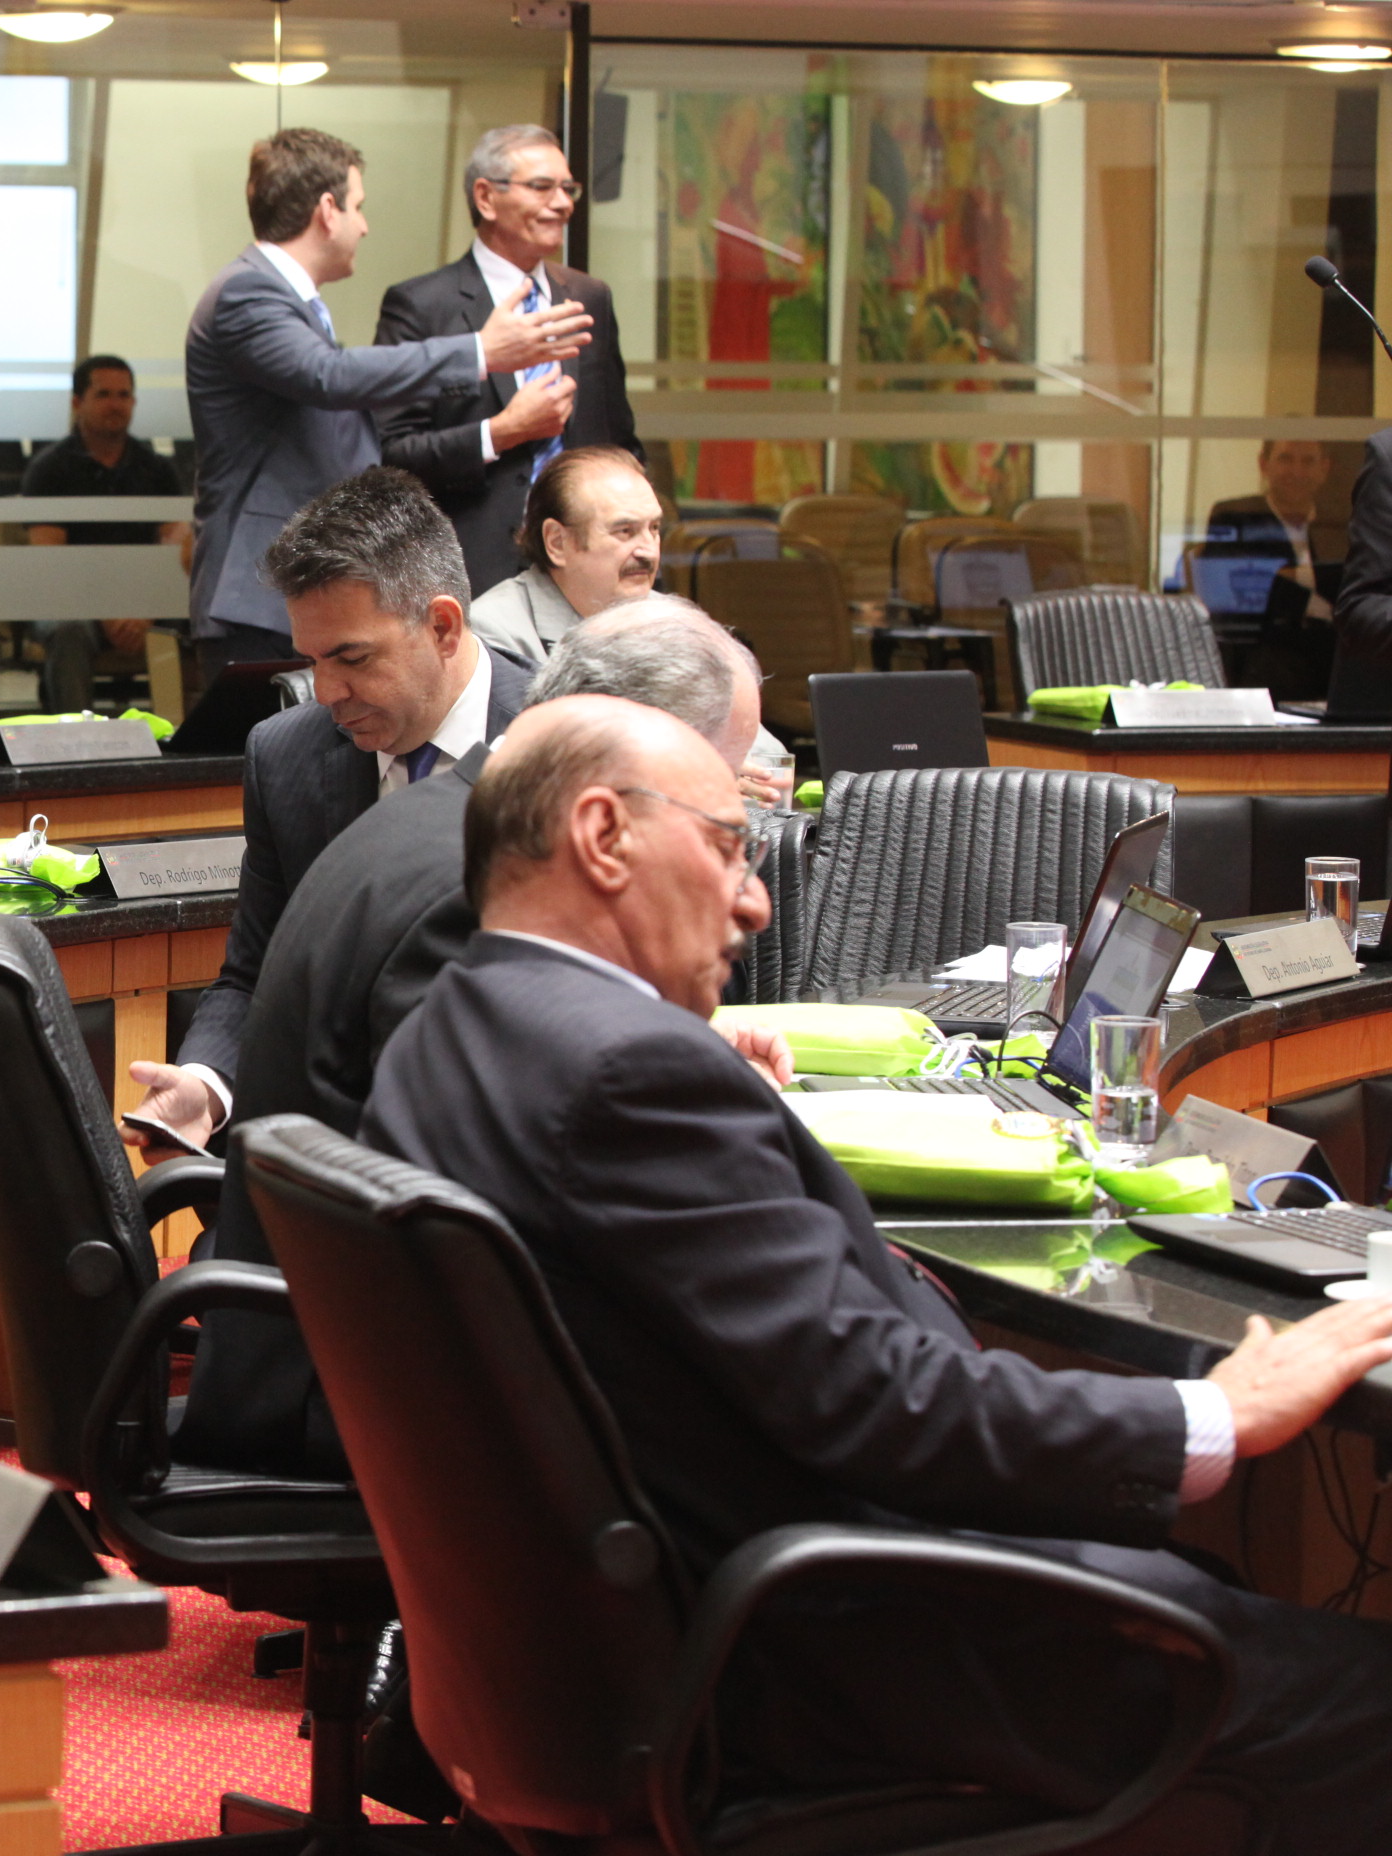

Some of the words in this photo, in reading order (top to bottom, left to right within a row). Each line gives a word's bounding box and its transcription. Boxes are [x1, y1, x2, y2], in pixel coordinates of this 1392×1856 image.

[139, 871, 166, 888] Dep.
[166, 867, 208, 885] Rodrigo
[1262, 965, 1283, 983] Dep.
[1281, 956, 1310, 977] Antonio
[1309, 952, 1334, 974] Aguiar
